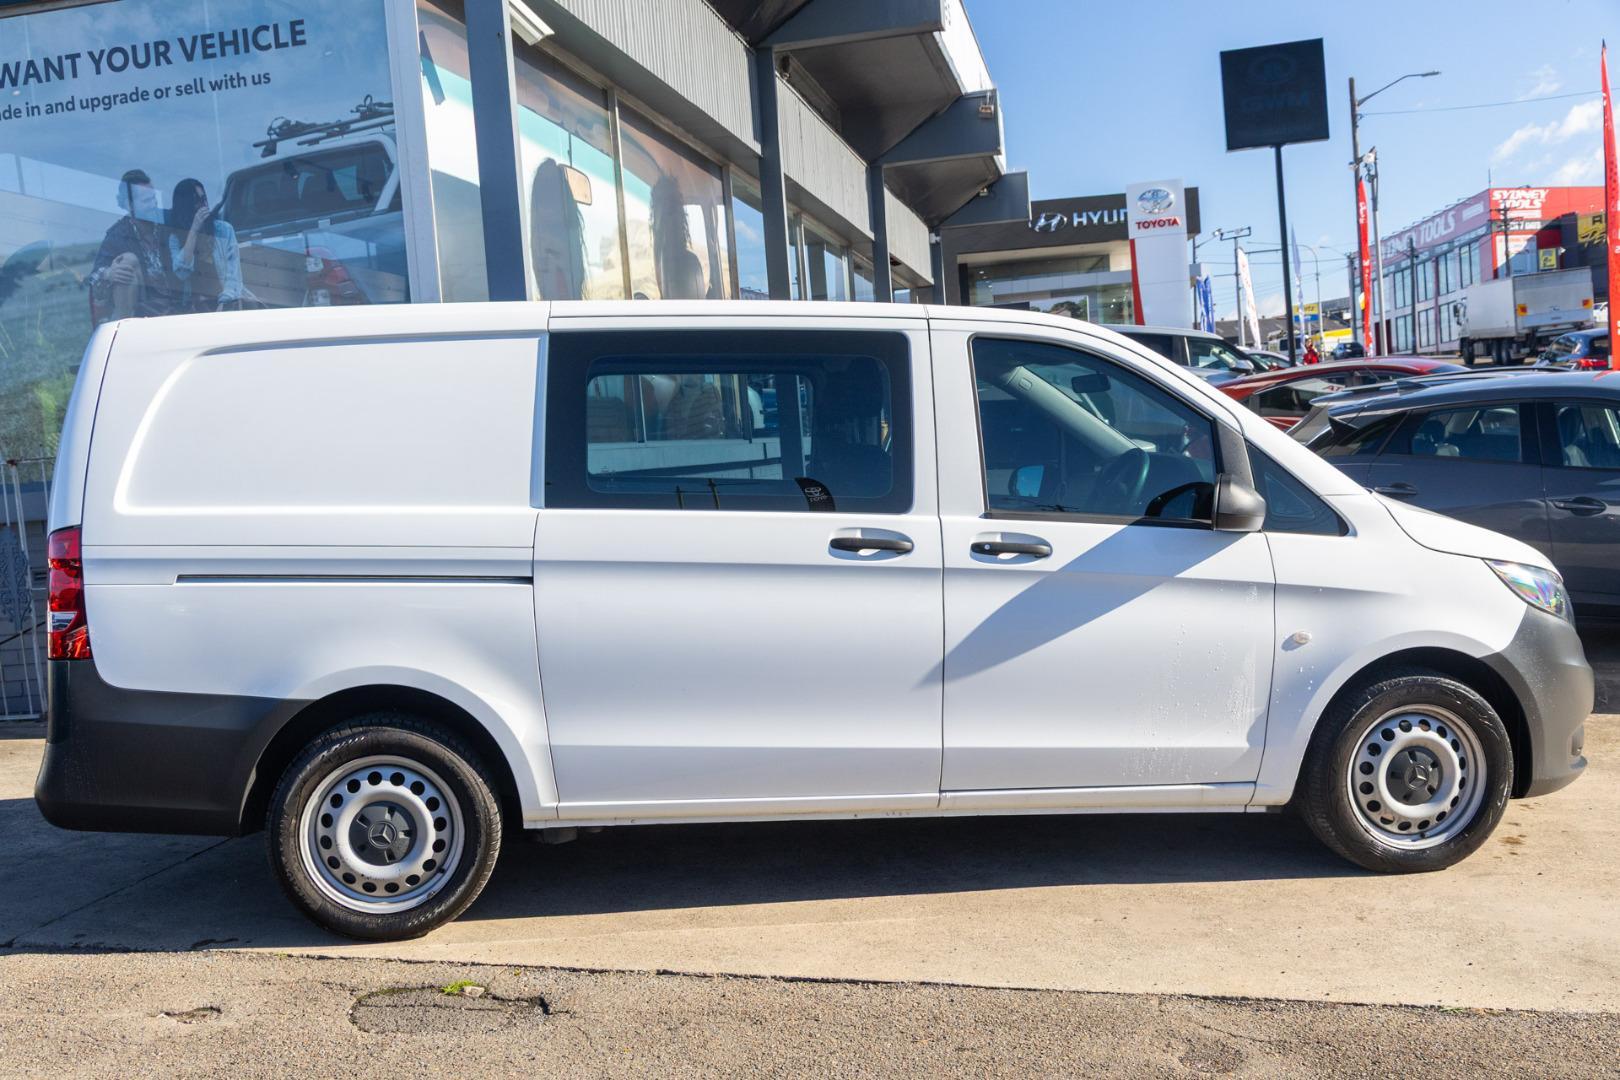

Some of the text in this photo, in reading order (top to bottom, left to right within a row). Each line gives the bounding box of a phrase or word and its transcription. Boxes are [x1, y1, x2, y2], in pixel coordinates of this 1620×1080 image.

[0, 19, 307, 89] WANT YOUR VEHICLE
[0, 72, 271, 121] de in and upgrade or sell with us
[1492, 189, 1549, 200] SYDNEY
[1498, 199, 1543, 209] TOOLS
[1136, 217, 1180, 230] TOYOTA
[1420, 210, 1457, 246] TOOLS
